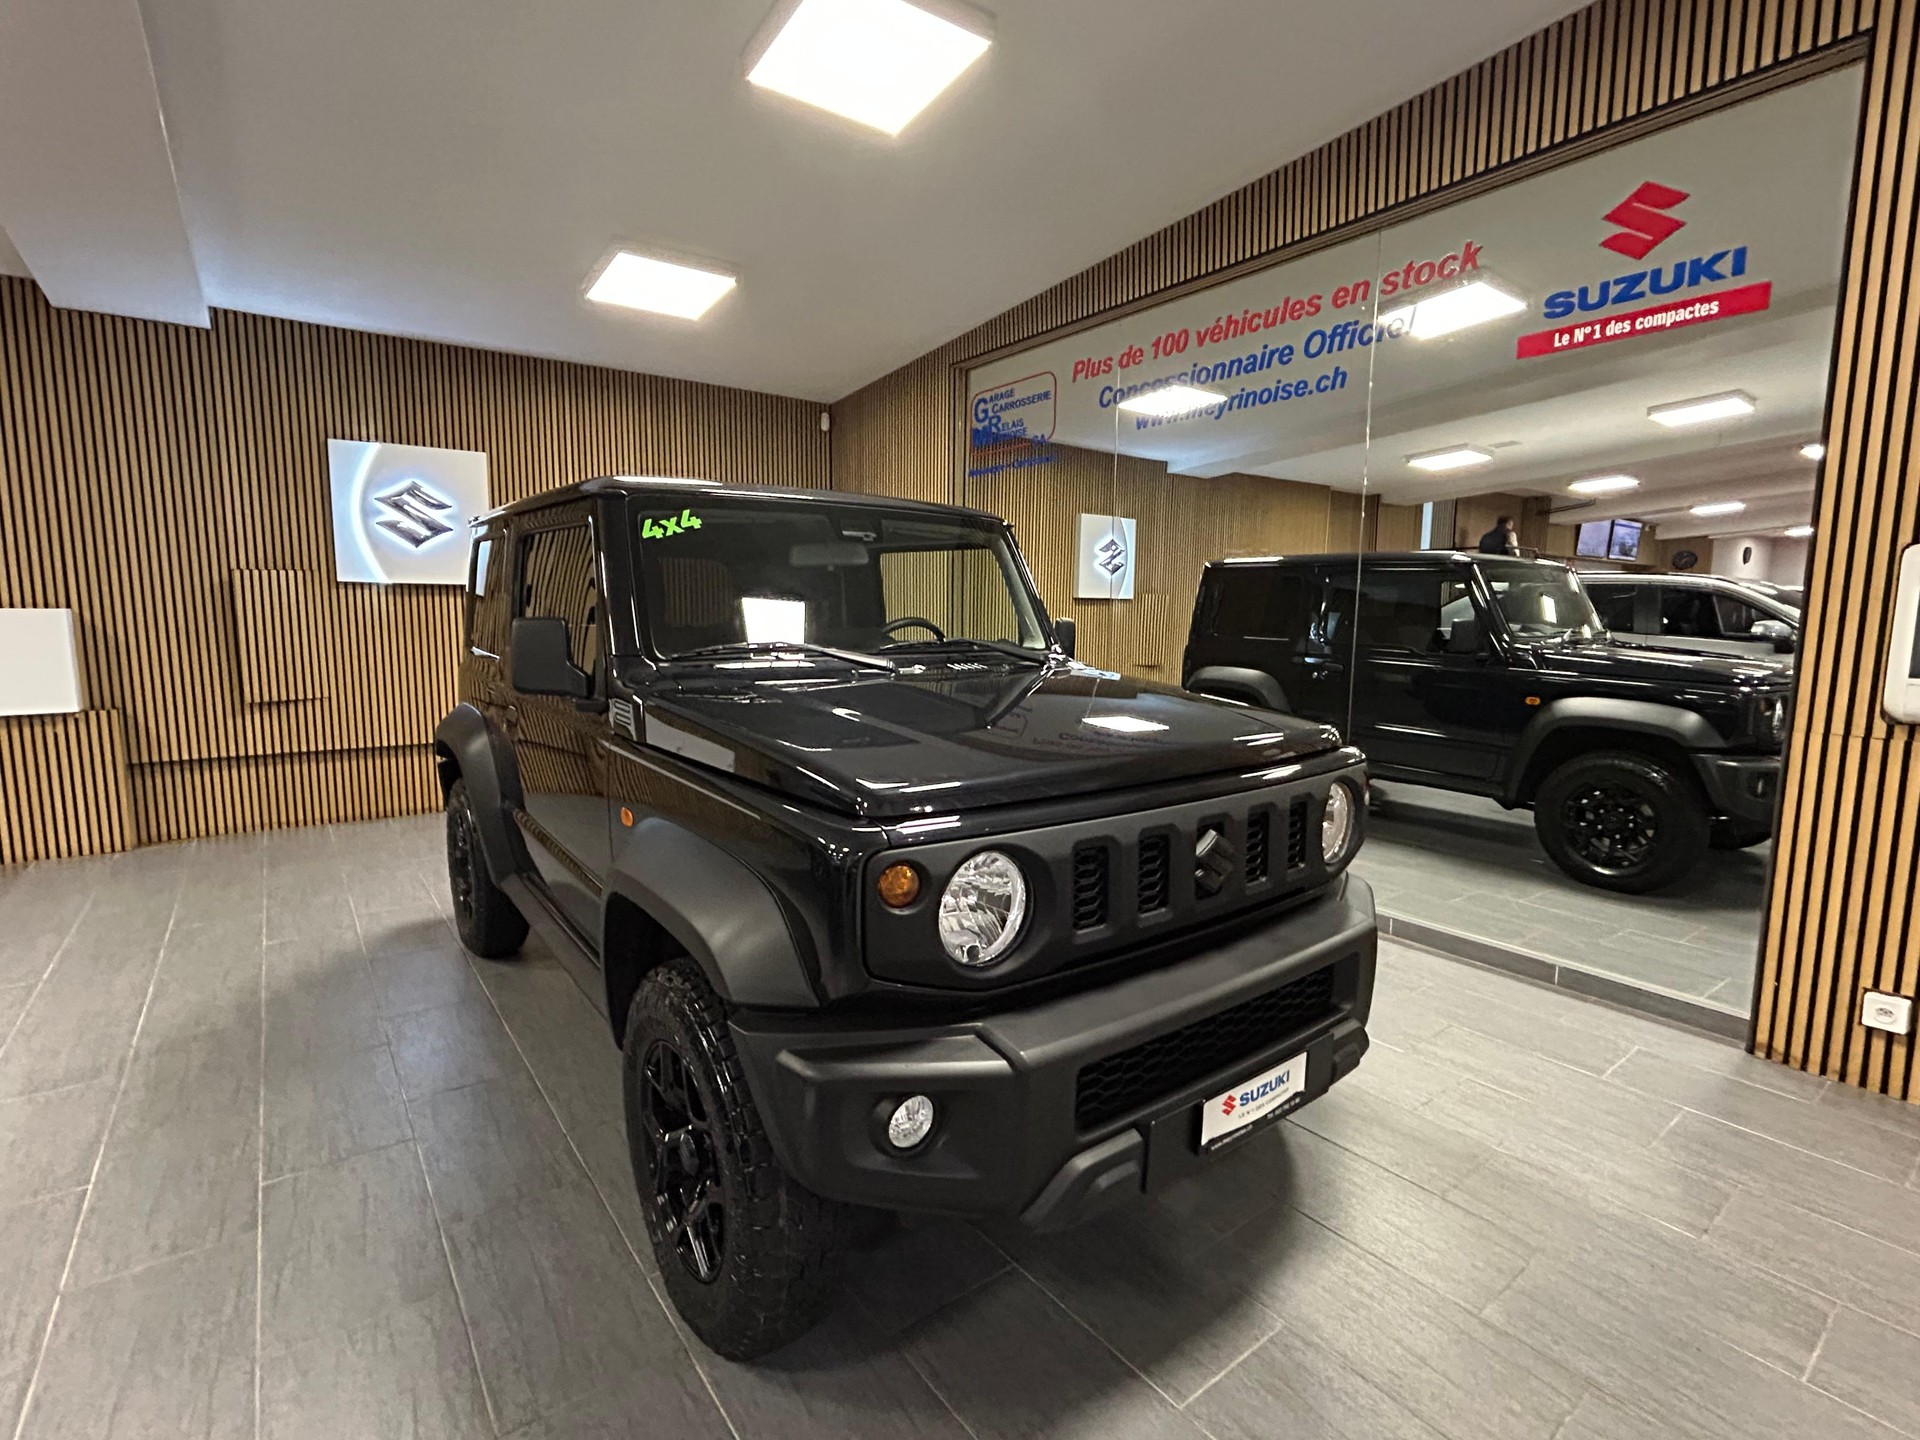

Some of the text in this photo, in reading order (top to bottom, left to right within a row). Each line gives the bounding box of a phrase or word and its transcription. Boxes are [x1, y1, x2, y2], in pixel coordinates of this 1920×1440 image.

[1543, 246, 1747, 319] SUZUKI
[1072, 239, 1483, 383] Plus de 100 véhicules en stock
[1554, 333, 1570, 348] Le
[1606, 320, 1631, 336] des
[1635, 301, 1719, 329] compactes
[1304, 305, 1416, 359] Officiel
[974, 388, 1015, 423] GARAGE
[992, 390, 1051, 414] CARROSSERIE
[988, 415, 1024, 433] RELAIS
[642, 509, 702, 539] 4x4
[1239, 1070, 1290, 1107] SUZUKI
